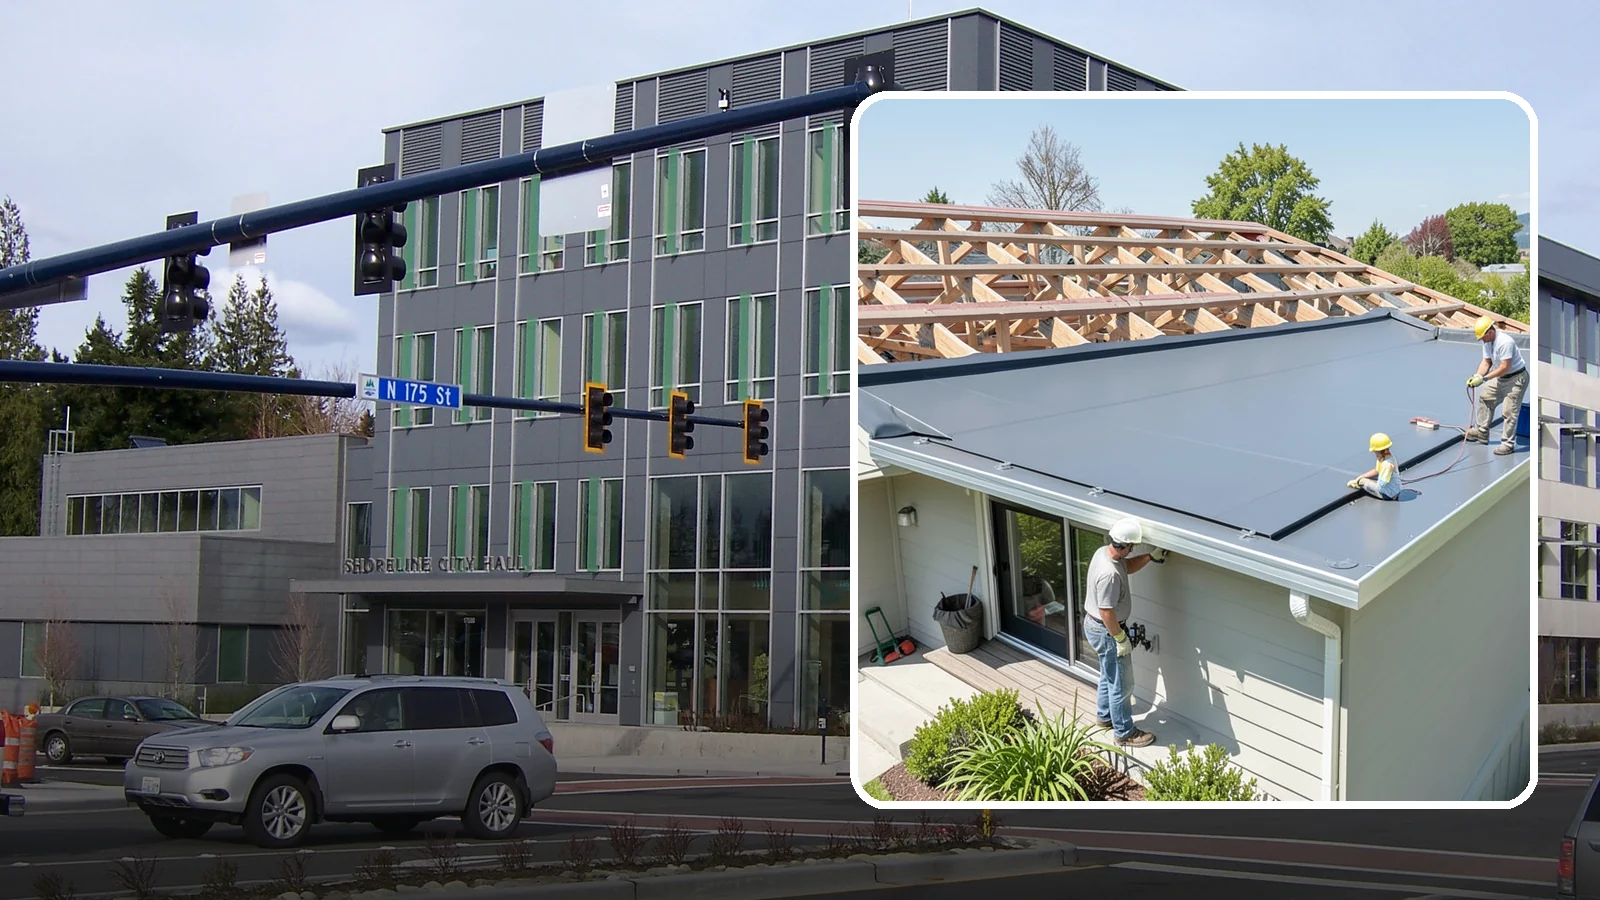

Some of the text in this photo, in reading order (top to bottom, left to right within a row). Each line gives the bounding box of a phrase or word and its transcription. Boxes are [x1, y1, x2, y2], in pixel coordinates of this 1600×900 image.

[387, 380, 451, 405] N 175 St
[344, 555, 526, 574] SHORELINE CITY HALL
